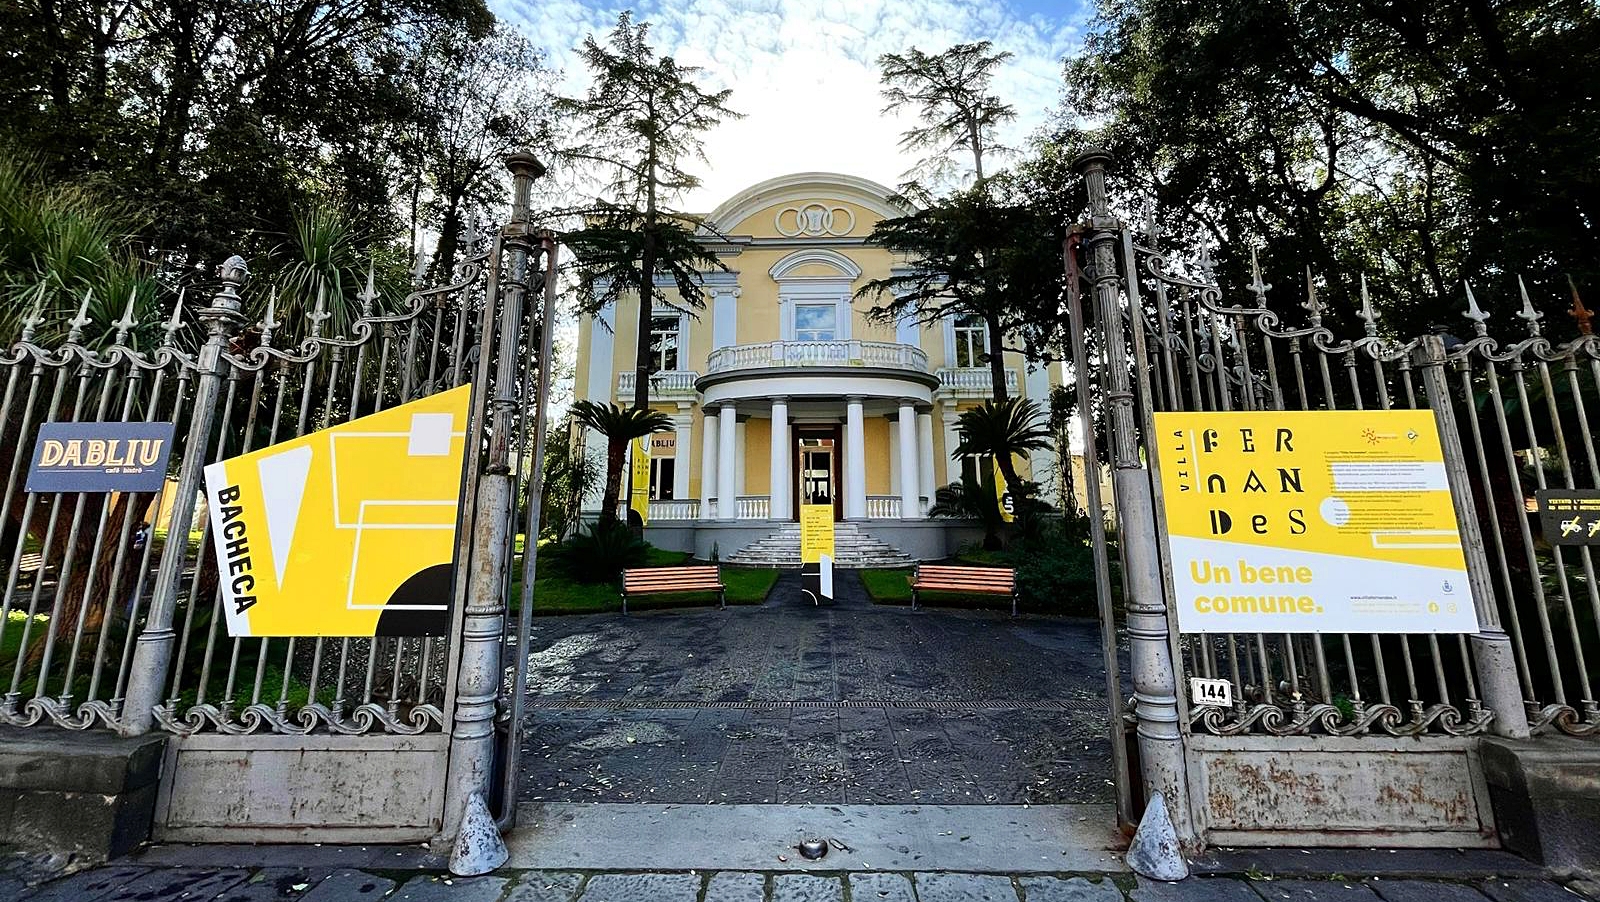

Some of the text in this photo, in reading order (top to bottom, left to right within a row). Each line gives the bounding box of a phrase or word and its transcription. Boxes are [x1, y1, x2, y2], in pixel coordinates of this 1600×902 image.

[38, 439, 164, 467] DABLIU
[1202, 428, 1294, 453] FER
[1173, 430, 1190, 492] VILLA
[218, 485, 258, 615] BACHECA
[1190, 559, 1313, 584] Un bene
[1194, 595, 1324, 614] comune.
[1200, 683, 1226, 699] 144
